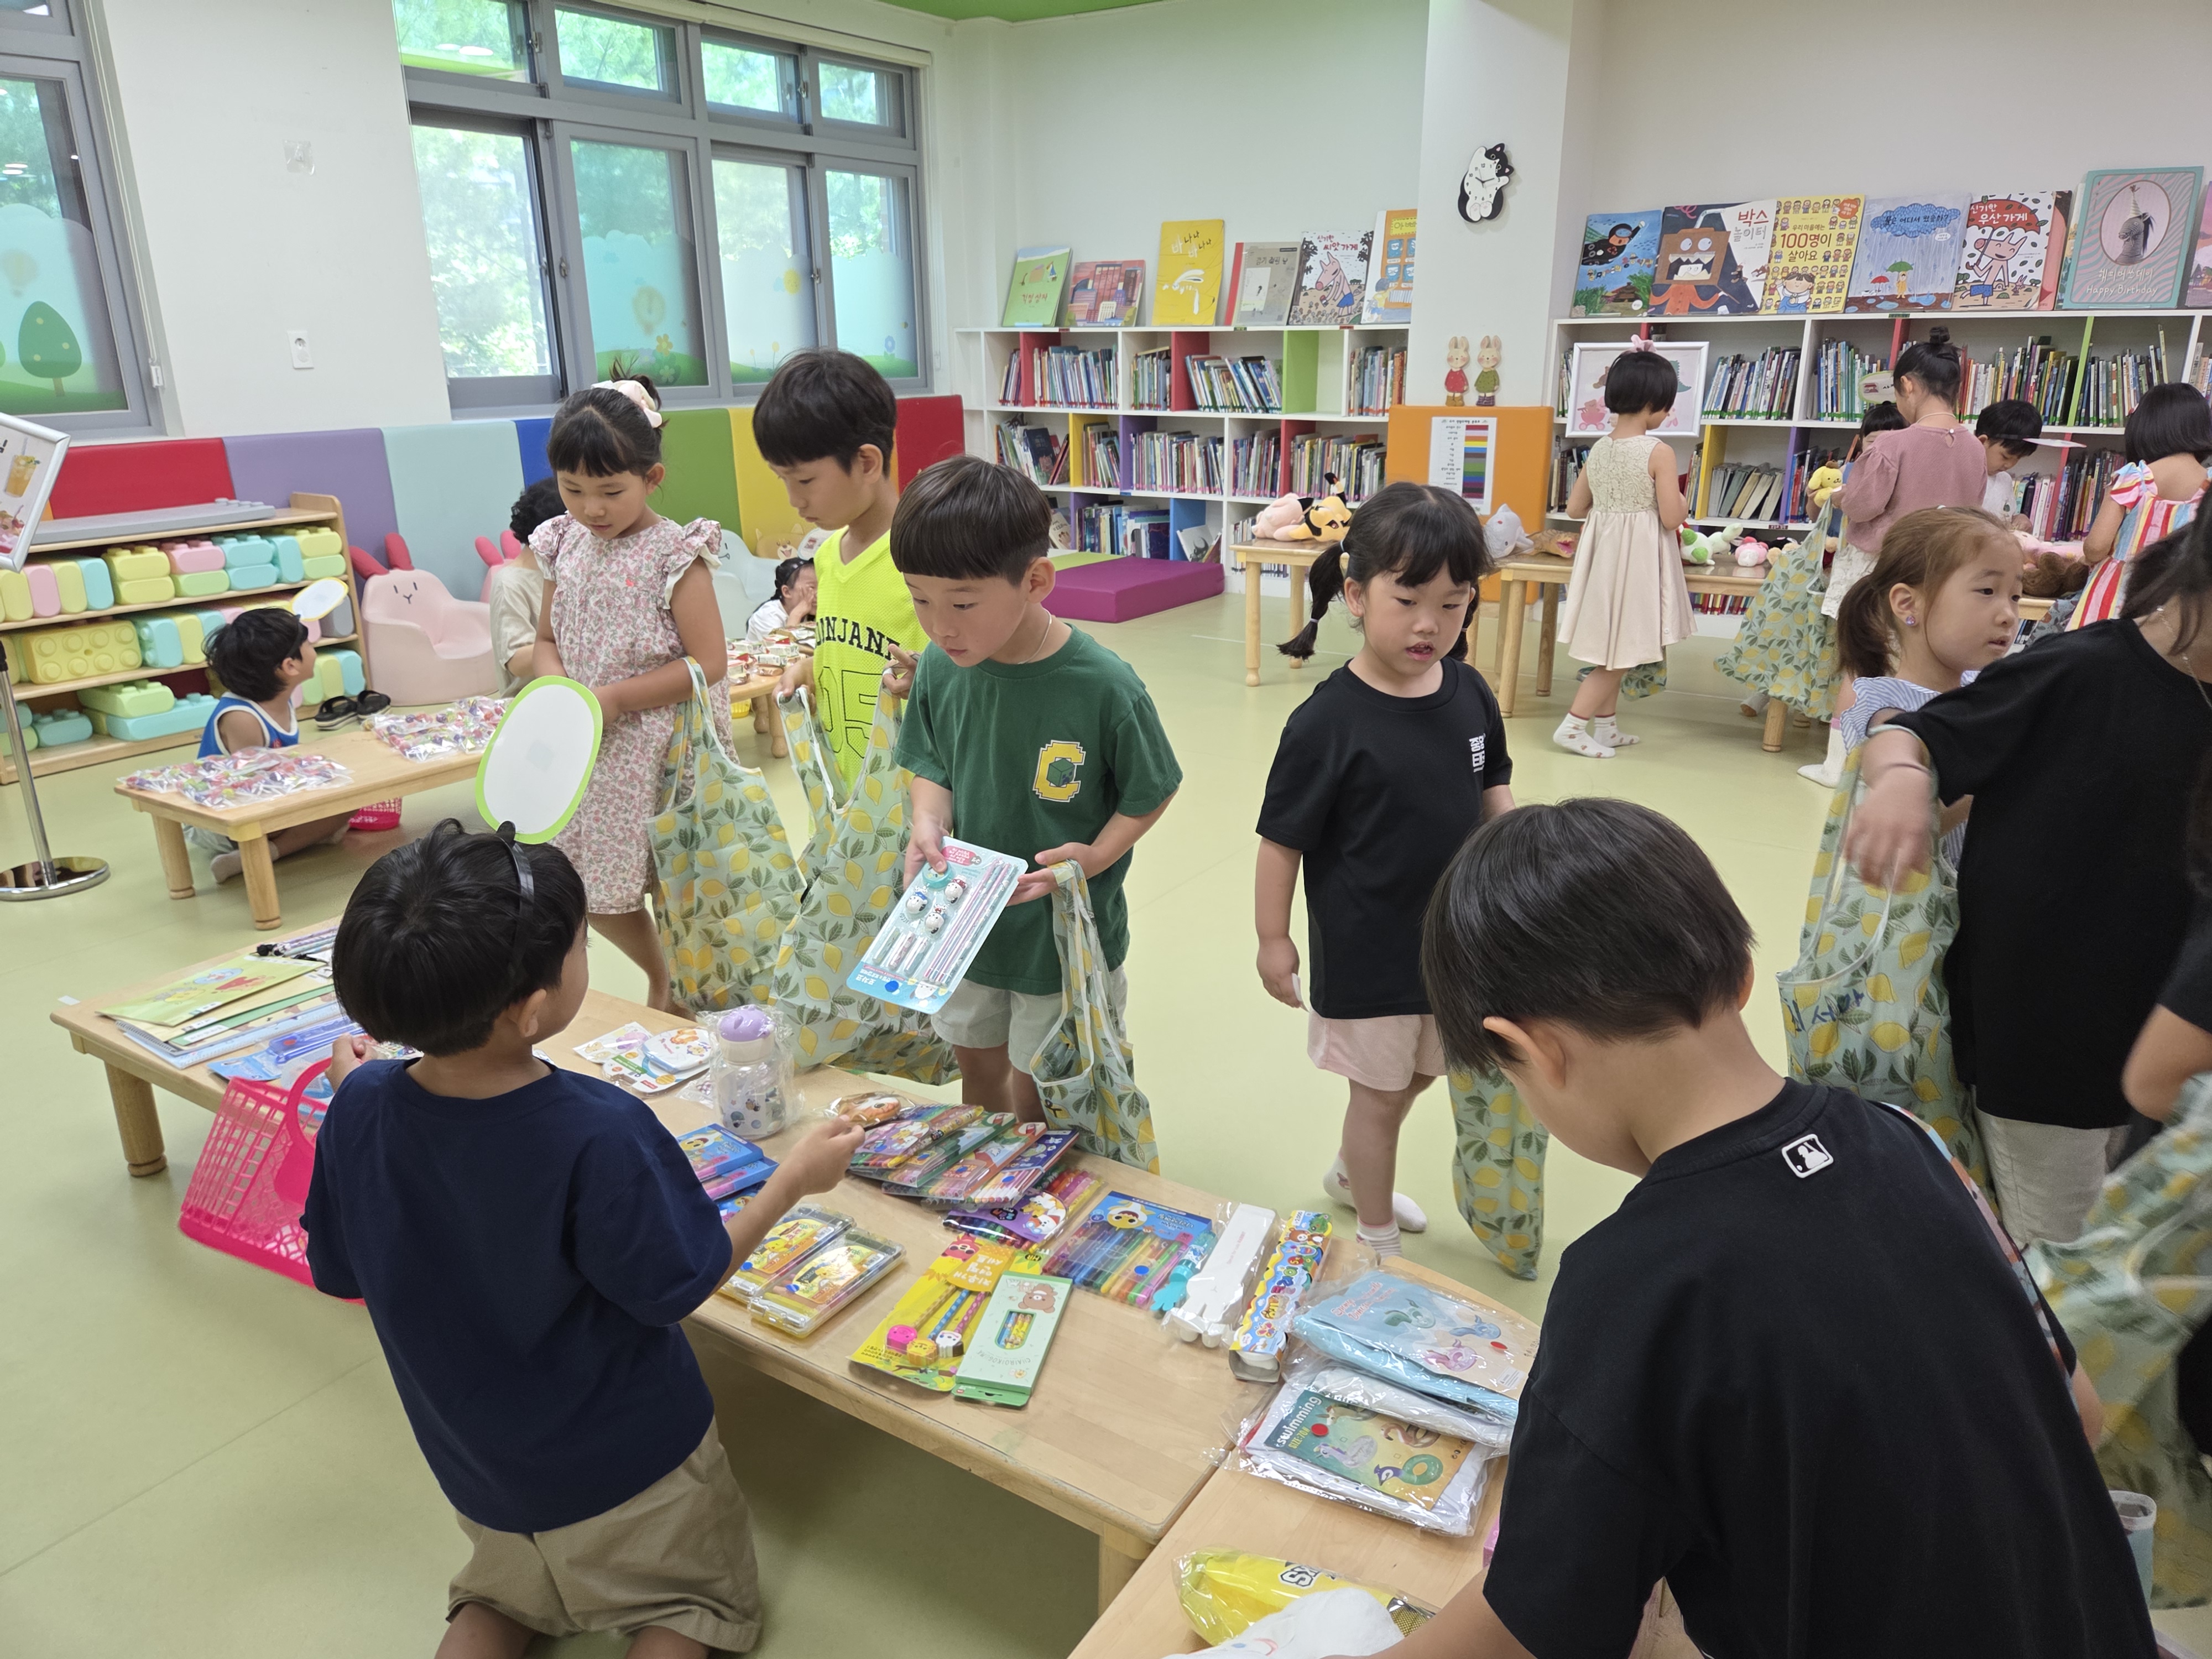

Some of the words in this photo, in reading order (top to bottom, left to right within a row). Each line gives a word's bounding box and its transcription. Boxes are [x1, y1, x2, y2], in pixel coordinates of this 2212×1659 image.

[1970, 204, 1997, 214] 신기한
[1738, 208, 1769, 227] 박스
[1979, 213, 2001, 225] 우산
[2003, 213, 2028, 222] 가게
[1734, 225, 1767, 242] 놀이터
[1781, 233, 1832, 248] 100명이
[1323, 242, 1340, 252] 씨앗
[1788, 250, 1818, 262] 살아요
[2086, 285, 2115, 297] Happy
[2118, 284, 2158, 297] Birthday
[1032, 739, 1086, 802] C
[975, 1254, 1004, 1266] 세트
[966, 1262, 993, 1277] 연필
[953, 1271, 992, 1286] 지우개
[1277, 1396, 1322, 1445] swimming
